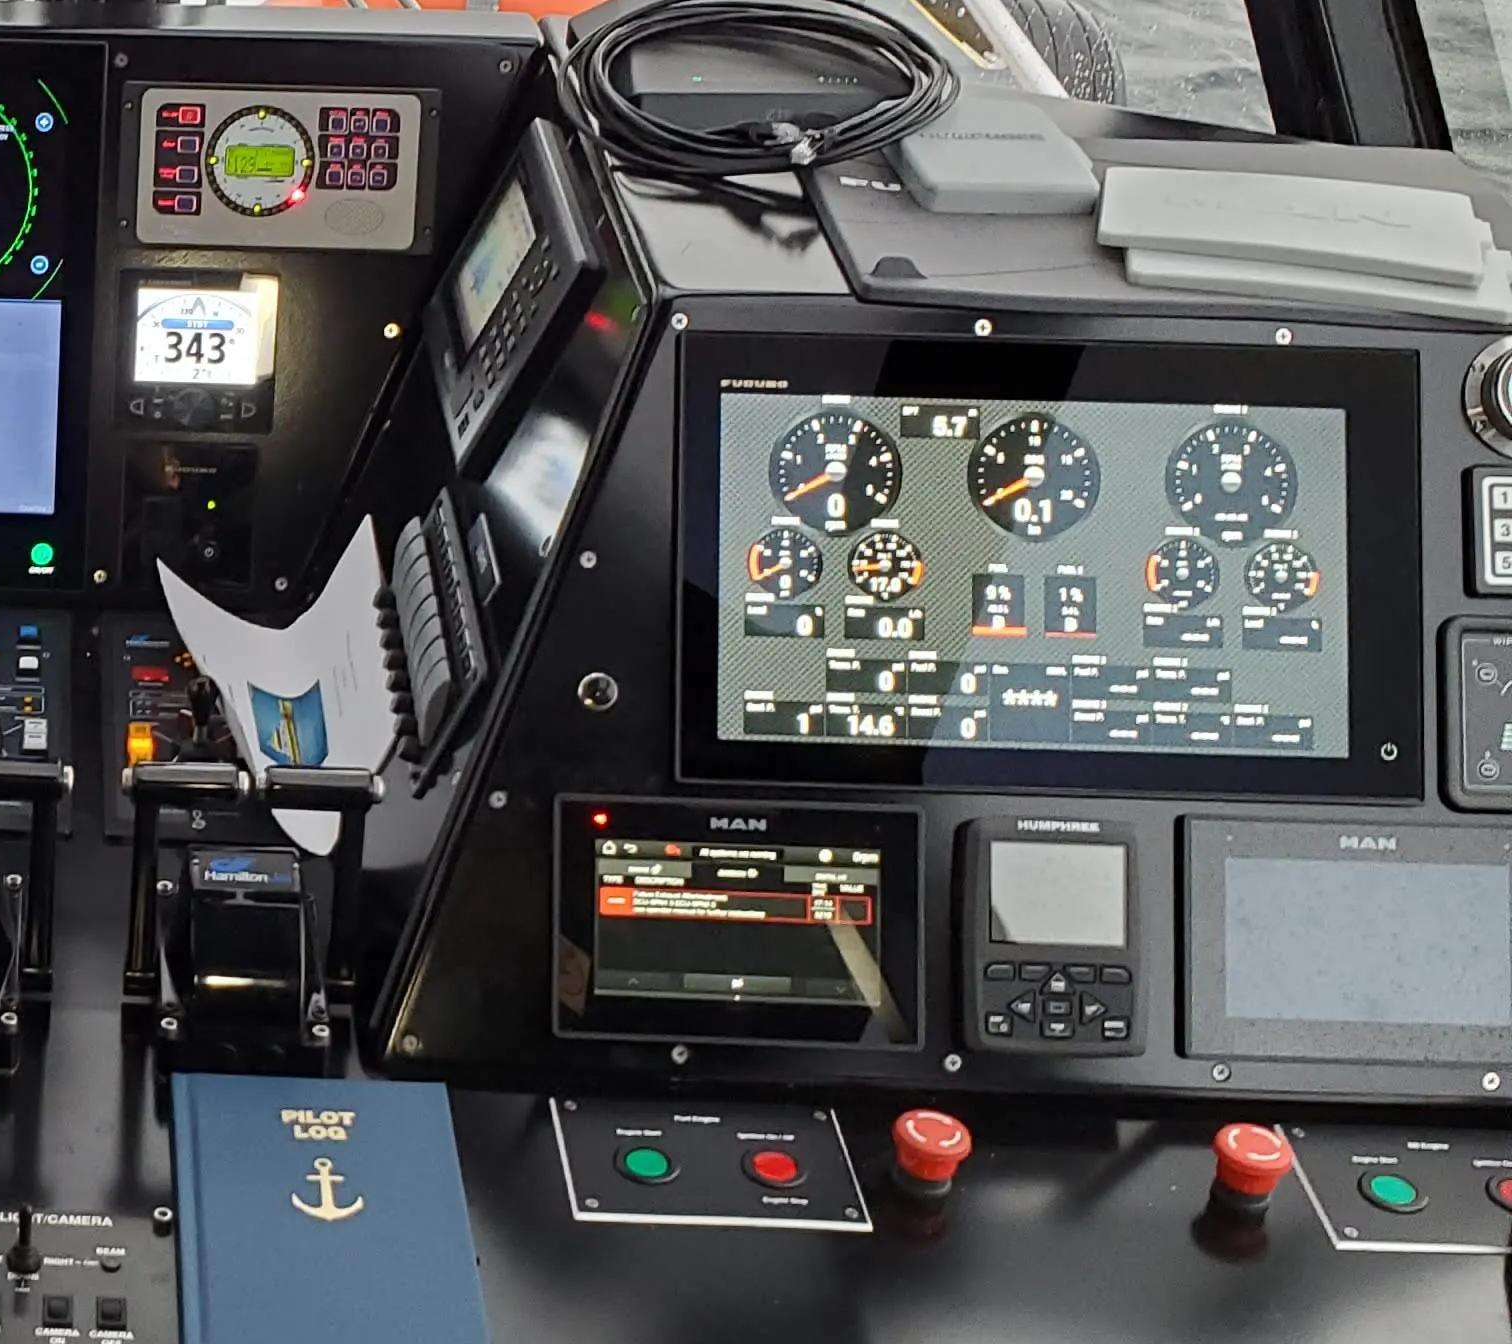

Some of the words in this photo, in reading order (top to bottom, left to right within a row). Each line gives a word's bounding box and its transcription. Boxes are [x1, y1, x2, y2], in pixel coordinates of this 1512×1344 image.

[720, 379, 788, 389] FURUNO
[933, 415, 968, 437] 5.7
[827, 493, 846, 517] 0
[1501, 490, 1508, 505] 1
[1014, 498, 1052, 523] 0.1
[1501, 523, 1512, 537] 3
[1502, 556, 1512, 570] 5
[796, 615, 813, 637] 0
[878, 617, 913, 638] 0.0
[878, 670, 895, 692] 0
[960, 672, 977, 694] 0
[848, 714, 896, 737] 14.6
[960, 717, 977, 739] 0
[710, 816, 767, 831] MAN
[1017, 819, 1100, 832] HUMPHREE
[1340, 835, 1397, 850] MAN
[281, 1109, 355, 1126] PILOT
[293, 1124, 347, 1140] LOG
[96, 1247, 126, 1255] BEAM
[43, 1257, 74, 1267] RIGHT
[35, 1327, 80, 1337] CAMERA
[89, 1330, 134, 1340] CAMERA
[49, 1336, 66, 1344] ON
